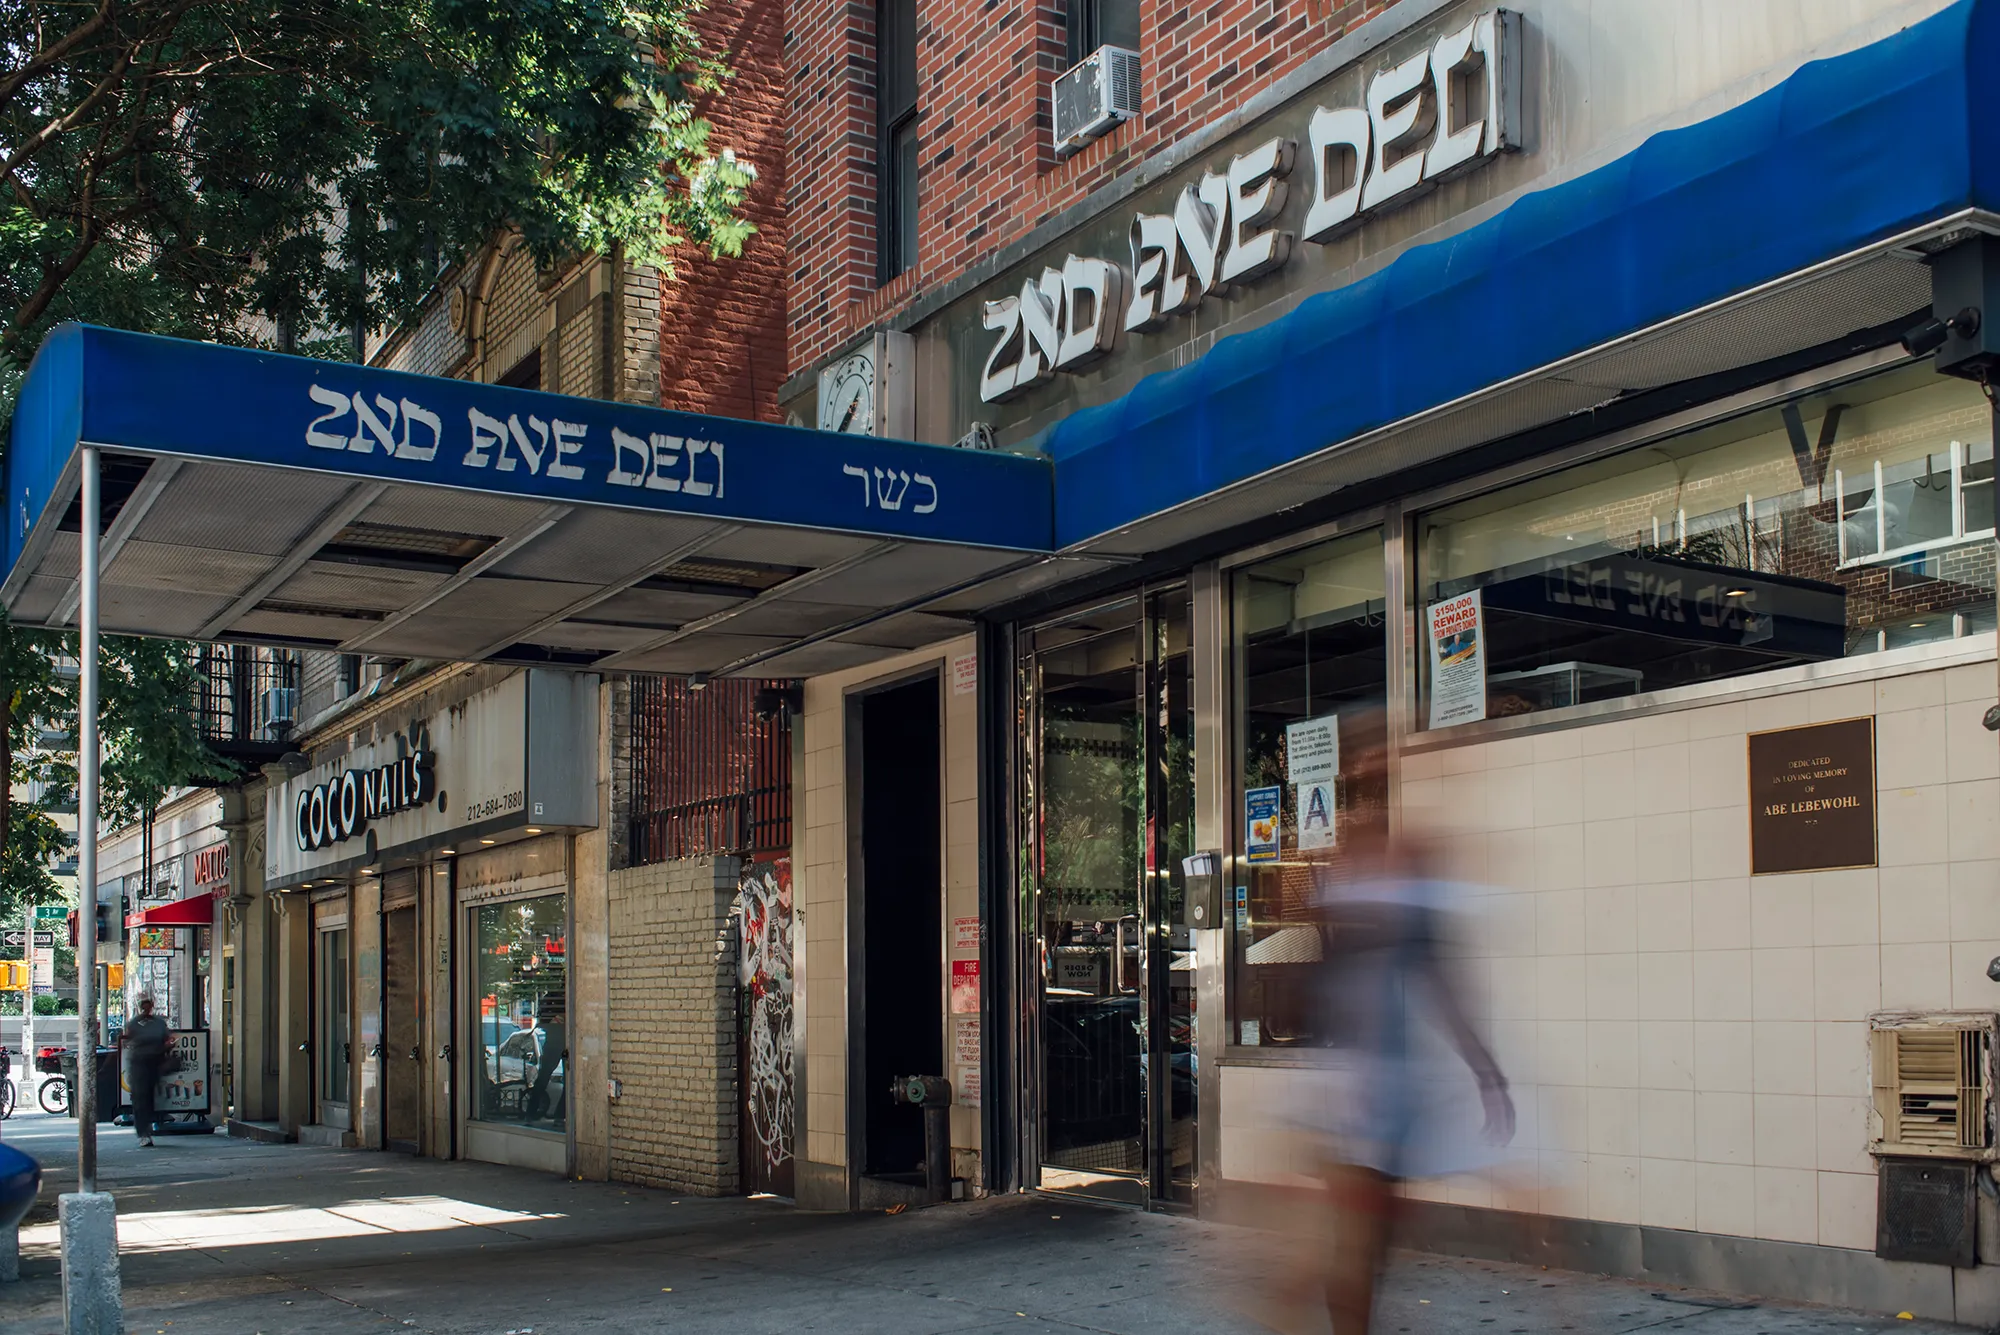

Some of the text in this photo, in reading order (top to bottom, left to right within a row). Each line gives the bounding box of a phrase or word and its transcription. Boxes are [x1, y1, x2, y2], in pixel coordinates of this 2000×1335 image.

[980, 9, 1508, 403] 2ND AVE DELI
[305, 383, 725, 500] 2ND AVE DELI
[842, 463, 938, 514] כשר
[1435, 596, 1473, 618] $150,000
[1433, 606, 1476, 630] REWARD
[1788, 756, 1831, 769] DEDICATED
[1783, 772, 1812, 783] LOVING
[1813, 767, 1848, 780] MEMORY
[1804, 784, 1815, 793] OF
[296, 750, 428, 852] COCO NAILS
[466, 790, 523, 822] 212-684-7880
[1304, 786, 1330, 831] A
[1763, 795, 1860, 816] ABE LEBEWOHL
[45, 908, 50, 917] 3
[33, 934, 49, 942] WAY
[964, 962, 977, 973] FIRE
[176, 1035, 198, 1048] .00
